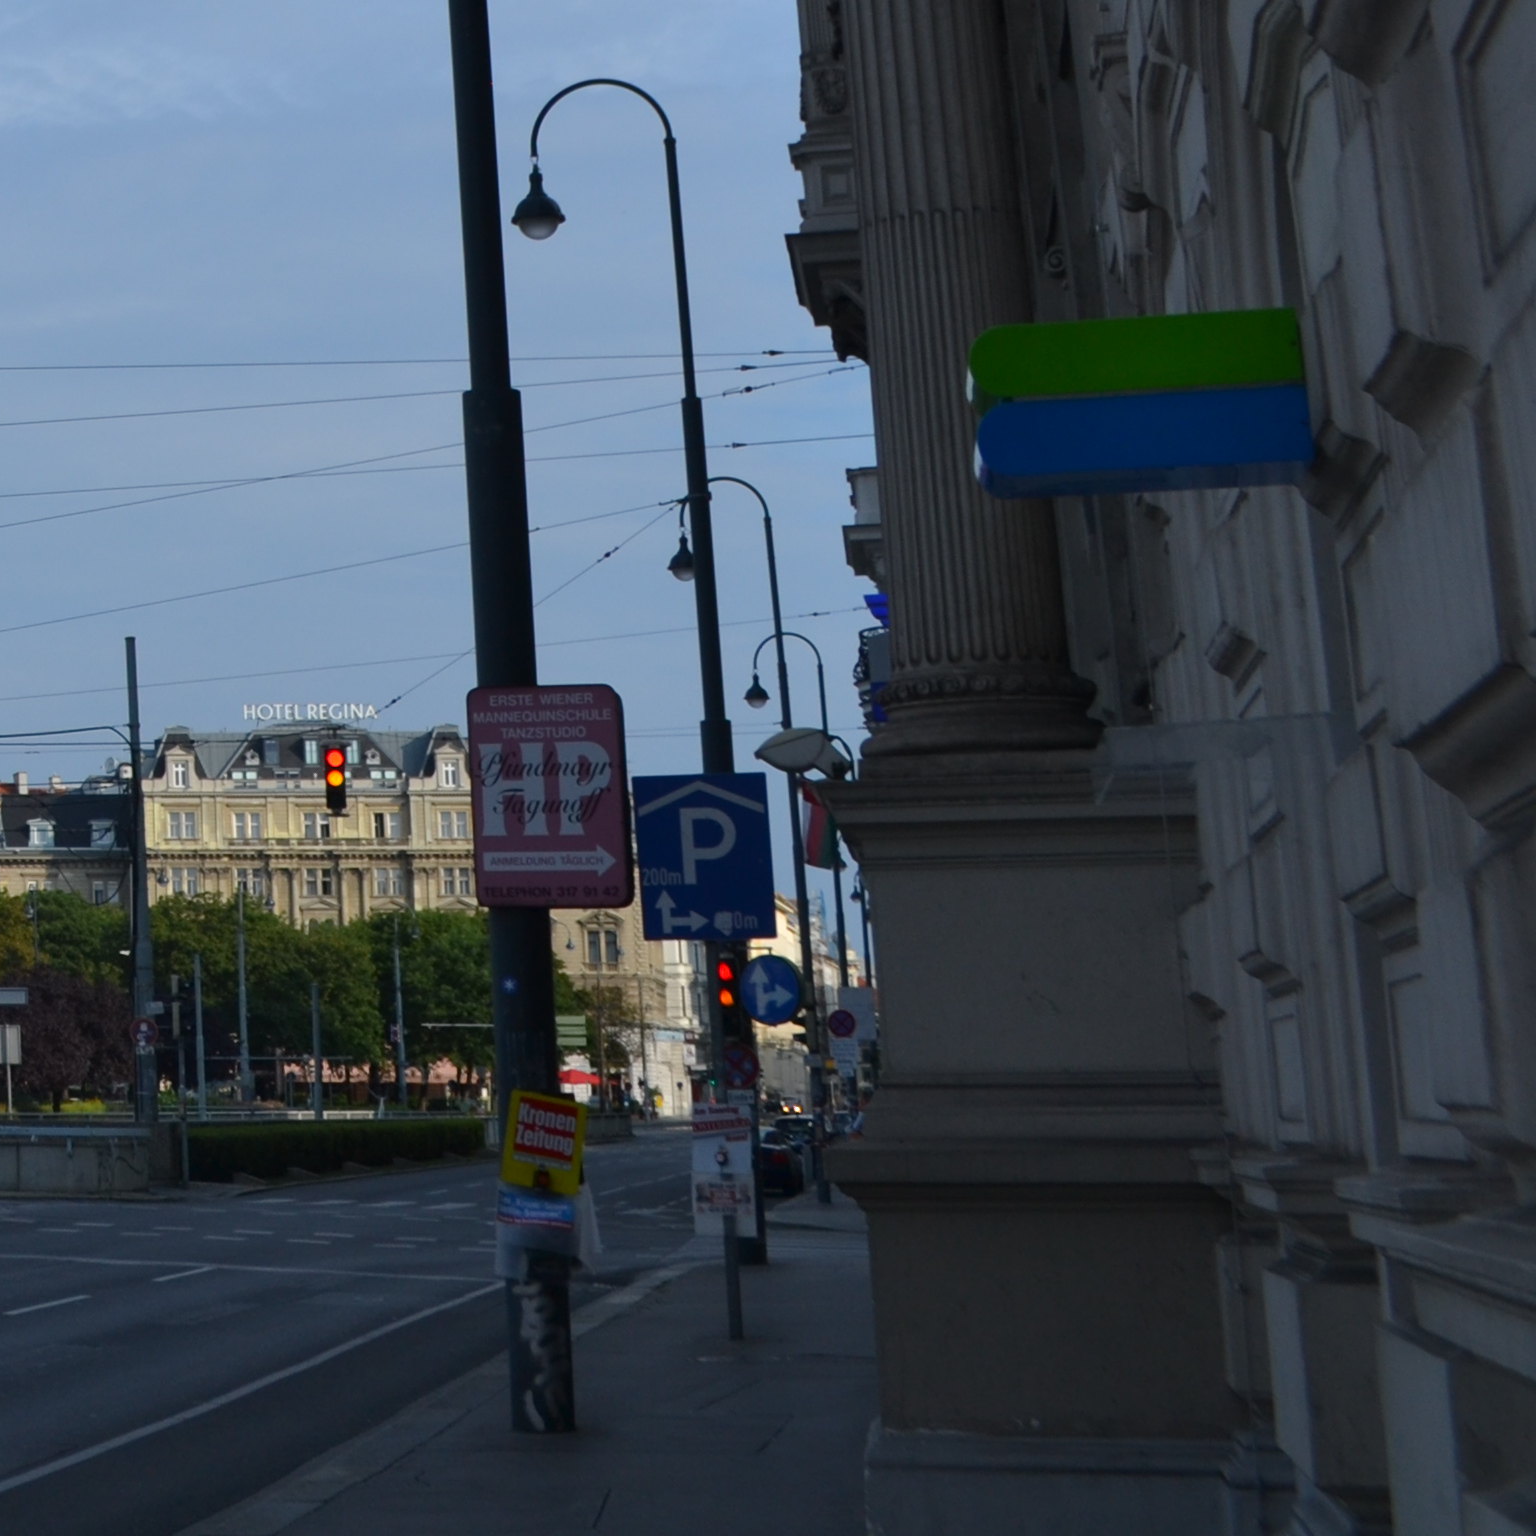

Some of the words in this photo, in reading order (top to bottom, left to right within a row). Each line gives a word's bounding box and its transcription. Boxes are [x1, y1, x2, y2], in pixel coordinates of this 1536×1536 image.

[489, 695, 533, 707] ERSTE
[539, 692, 594, 705] WIENER
[243, 704, 304, 720] HOTEL
[307, 703, 378, 720] REGINA
[473, 708, 612, 724] MANNEQUINSCHULE
[500, 726, 587, 739] TANZSTUDIO
[679, 807, 737, 885] P
[490, 856, 557, 867] ANMELDUNG
[560, 854, 604, 866] TÄGLICH
[642, 867, 682, 886] 200m
[484, 886, 552, 899] TELEPHON
[556, 885, 579, 898] 317
[582, 886, 598, 897] 91
[602, 885, 620, 897] 42
[518, 1101, 577, 1134] Kronen
[515, 1123, 573, 1156] Zeitung
